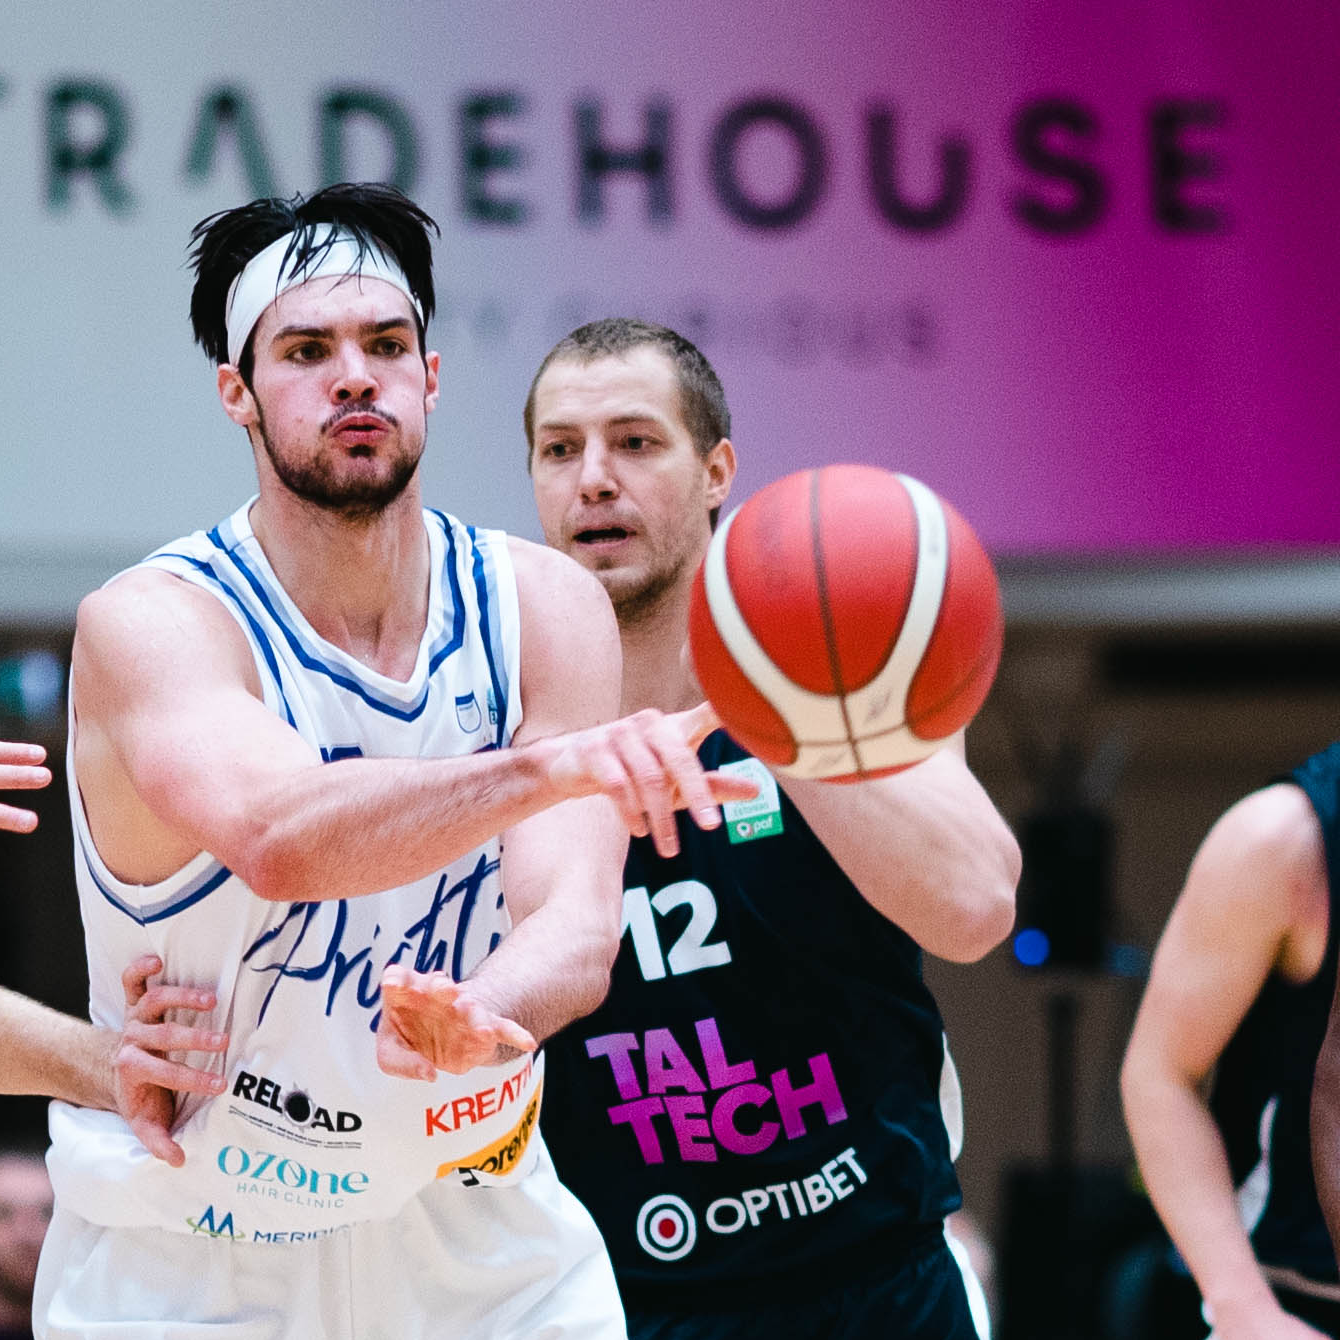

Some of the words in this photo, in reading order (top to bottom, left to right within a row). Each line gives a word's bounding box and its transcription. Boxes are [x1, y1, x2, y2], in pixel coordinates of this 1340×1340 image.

[620, 880, 733, 981] 12
[584, 1017, 757, 1100] TAL
[607, 1052, 849, 1165] TECH
[236, 1182, 279, 1199] HAIR
[283, 1191, 345, 1209] CLINIC
[705, 1147, 869, 1234] OPTIBET
